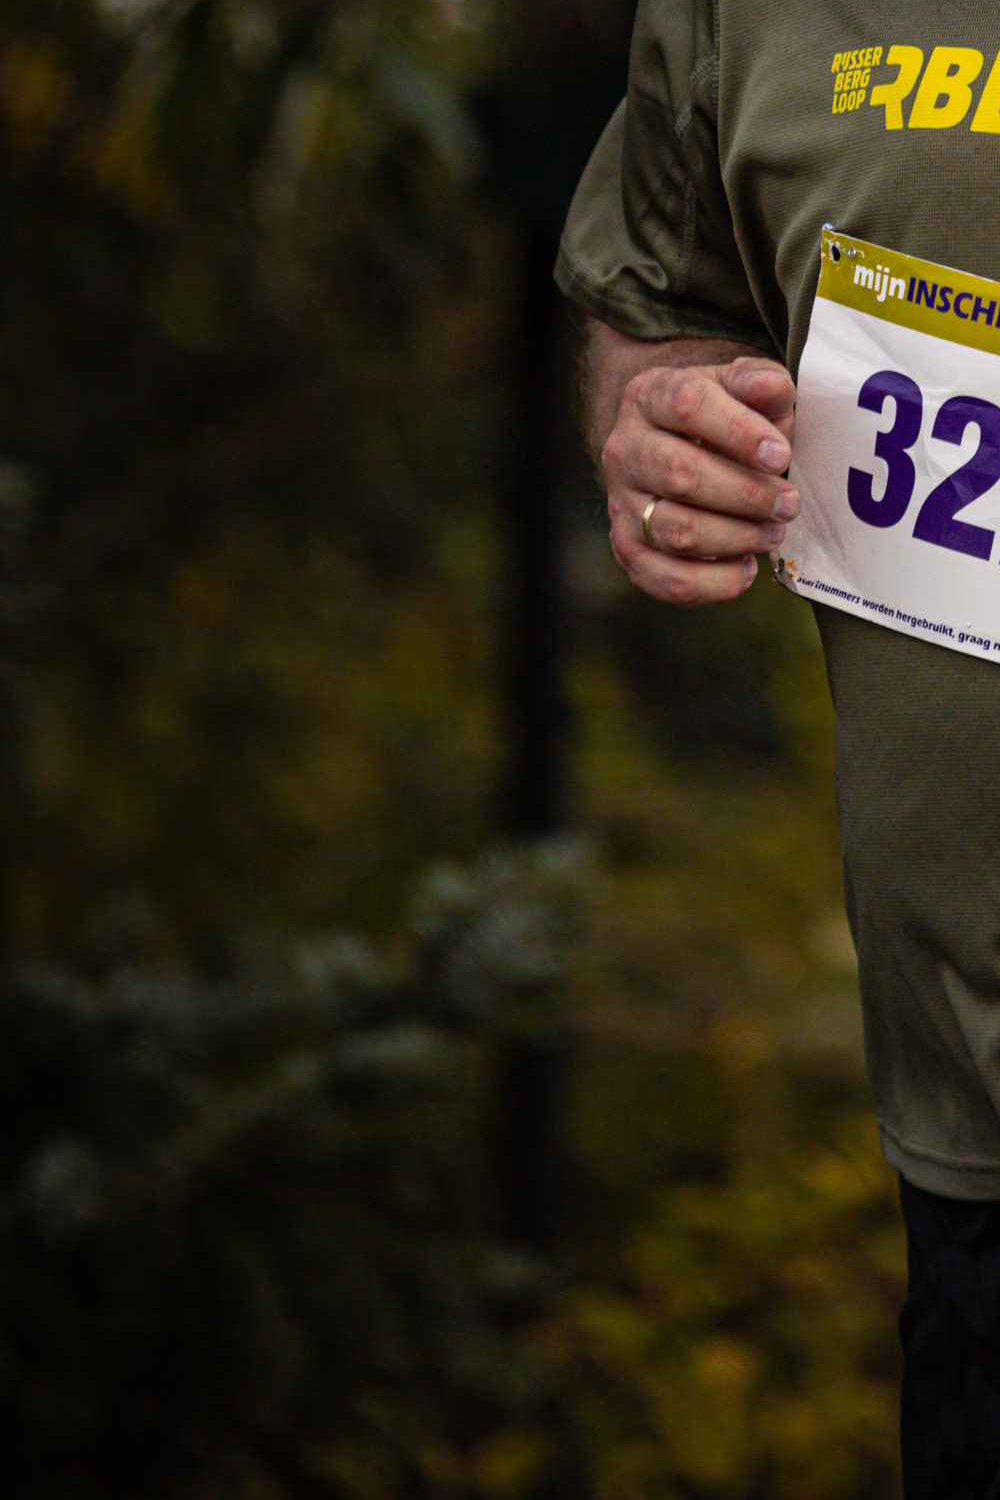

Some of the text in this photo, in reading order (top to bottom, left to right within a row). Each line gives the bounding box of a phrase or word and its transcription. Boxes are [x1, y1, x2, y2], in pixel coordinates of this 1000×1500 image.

[834, 68, 871, 93] BERG
[831, 89, 866, 114] LOOP
[862, 598, 894, 617] worden
[896, 610, 955, 639] hergebruikt,
[958, 632, 991, 650] graag
